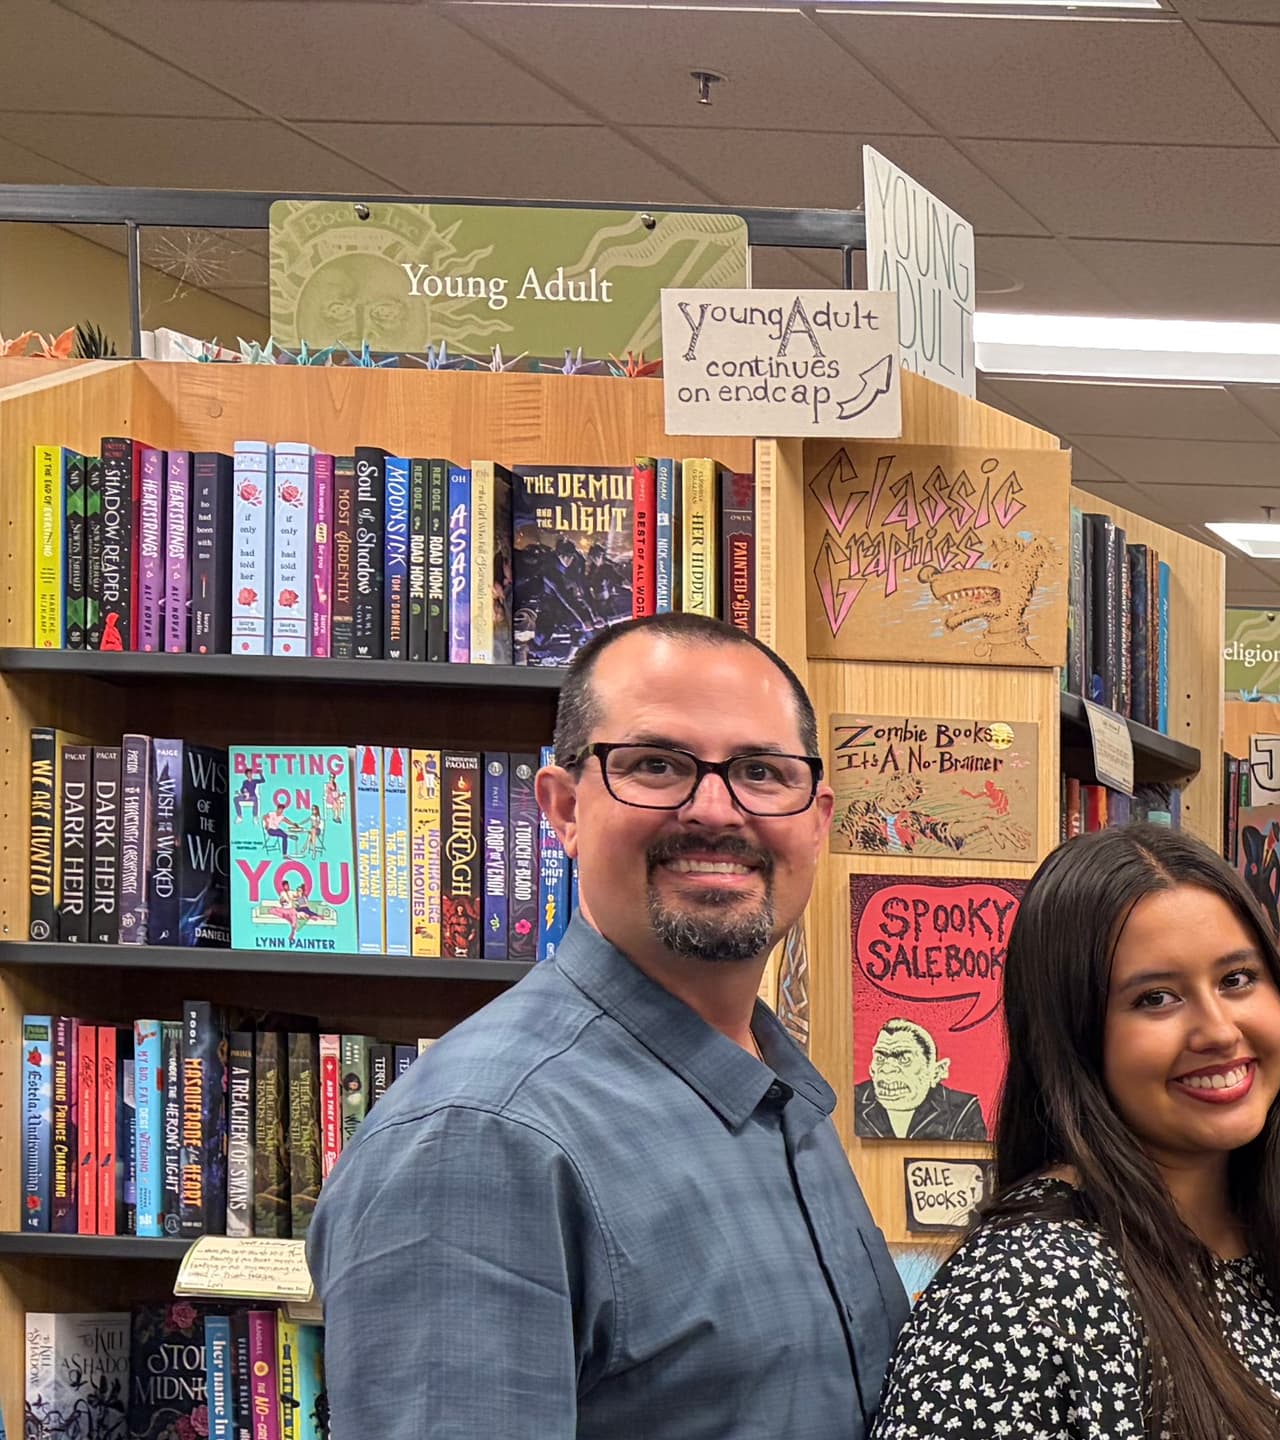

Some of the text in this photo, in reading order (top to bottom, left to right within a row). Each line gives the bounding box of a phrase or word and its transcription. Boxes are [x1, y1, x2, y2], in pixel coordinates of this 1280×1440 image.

[869, 155, 971, 302] YOUNG
[401, 264, 613, 309] Young Adult
[678, 297, 879, 361] Young Adult
[707, 357, 840, 379] continues
[678, 384, 831, 423] on endcap
[104, 469, 121, 540] SHADOW
[523, 474, 554, 494] THE
[809, 448, 1025, 536] Classic
[142, 479, 159, 559] HEARTSTRINGS
[169, 481, 185, 560] HEARTSTRINGS
[357, 460, 378, 595] Soul Shadow
[387, 465, 408, 568] MOONSICK
[555, 501, 627, 534] LIGHT
[101, 545, 120, 602] REAPER
[335, 488, 352, 603] MOST ARDENTLY
[410, 534, 425, 599] ROAD HOME
[429, 535, 444, 600] ROAD HOME
[636, 512, 646, 583] BEST ALL
[733, 541, 748, 593] PAINTED
[691, 552, 705, 610] HIDDEN
[812, 529, 985, 639] Graphics
[835, 719, 928, 751] Zombie
[836, 743, 1003, 774] It's No-Brainer
[233, 753, 346, 778] BETTING
[272, 788, 311, 810] ON
[62, 782, 85, 915] DARK HEIR
[93, 781, 116, 914] DARK HEIR
[153, 778, 176, 898] WISH WICKED
[446, 789, 477, 896] MURTAGH
[541, 851, 563, 859] HERE
[546, 859, 557, 867] TO
[234, 860, 350, 905] YOU
[414, 834, 425, 917] THE MOVIES
[541, 869, 563, 877] SHUT
[546, 878, 557, 886] UP
[255, 937, 335, 951] LYNN PAINTER
[879, 897, 1015, 944] SPOOKY
[866, 940, 1007, 985] SALE BOOK
[189, 1011, 197, 1045] POOL
[55, 1061, 68, 1198] FINDING PRINCE CHARMING
[183, 1057, 202, 1208] MASQUERADE HEART
[230, 1077, 249, 1210] TREACHERY SWANS
[165, 1155, 179, 1194] LIGHT
[911, 1167, 953, 1189] SALE
